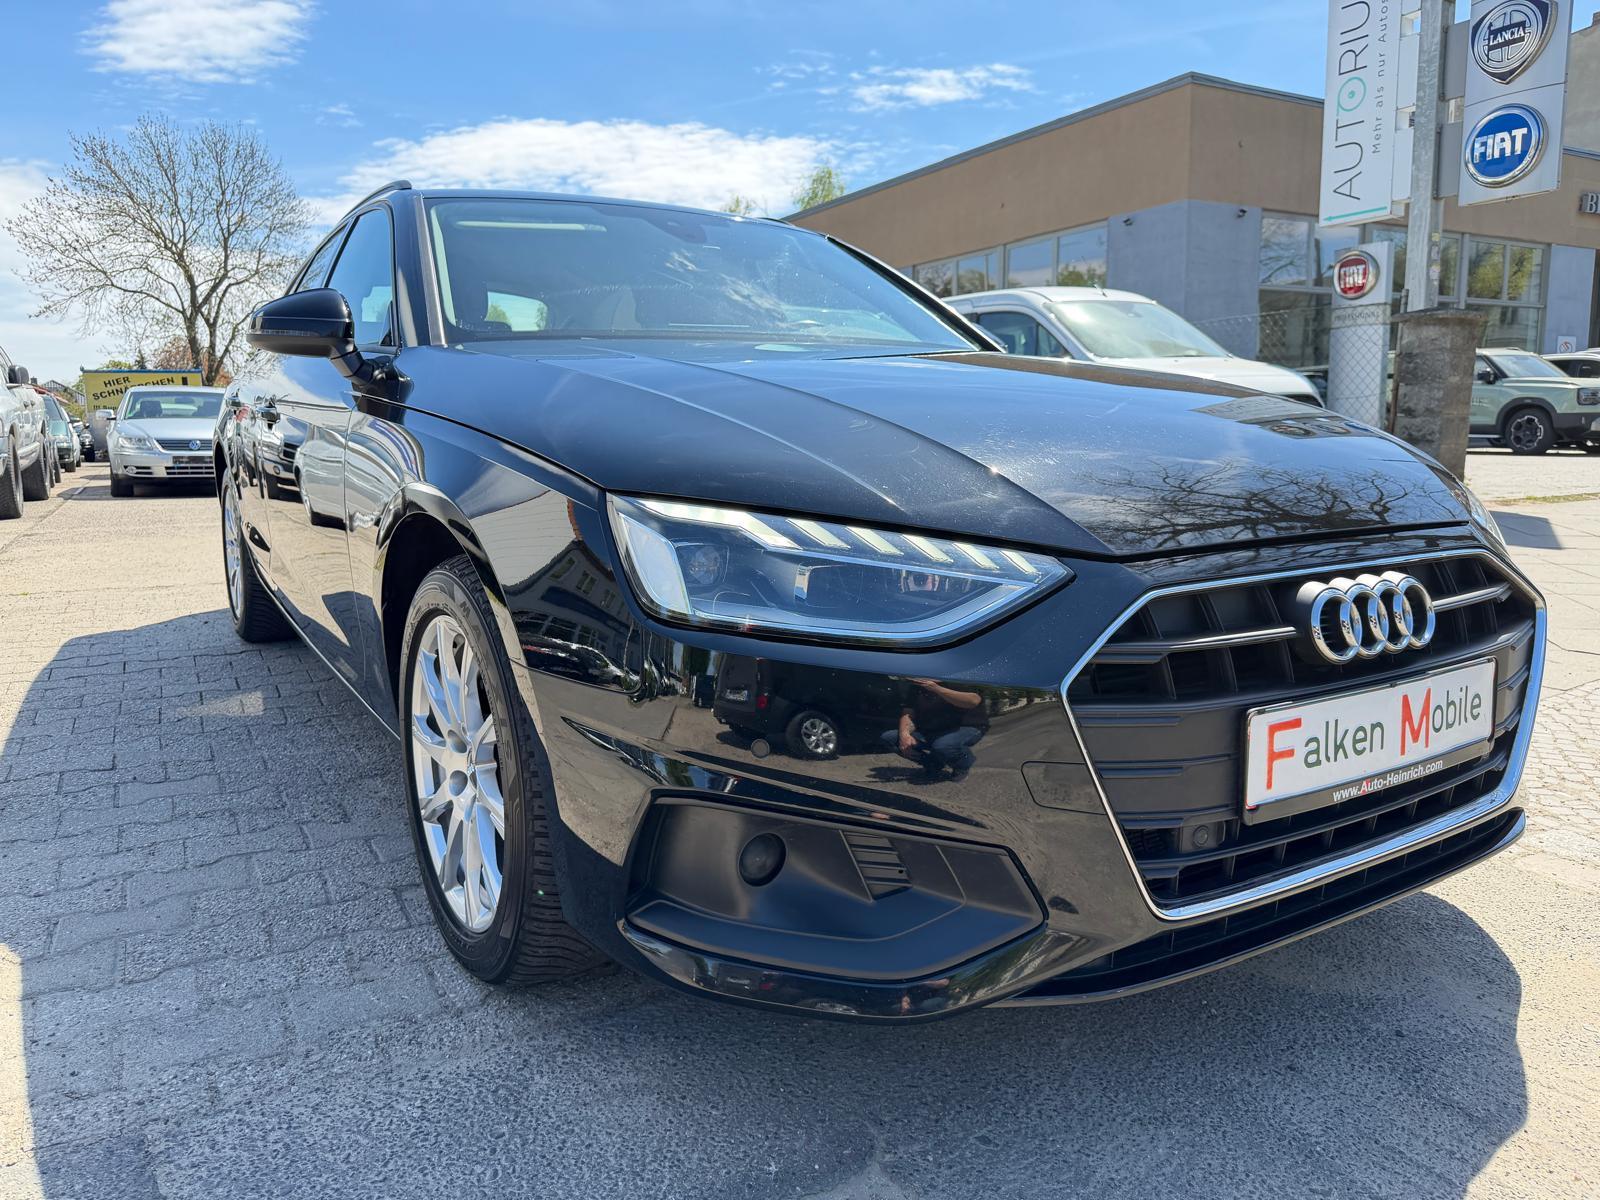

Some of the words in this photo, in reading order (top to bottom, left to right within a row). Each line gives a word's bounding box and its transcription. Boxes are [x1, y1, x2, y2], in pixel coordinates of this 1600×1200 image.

[1489, 26, 1525, 46] LANCIA
[1377, 52, 1386, 77] nur
[1374, 86, 1384, 108] als
[1371, 116, 1383, 154] Mehr
[1473, 127, 1528, 164] FIAT
[92, 377, 175, 401] SCHNCHEN
[103, 376, 131, 388] HIER
[1265, 717, 1385, 790] Falken
[1400, 685, 1482, 757] Mobile
[1332, 760, 1444, 802] www.Auto-Heinrich.com
